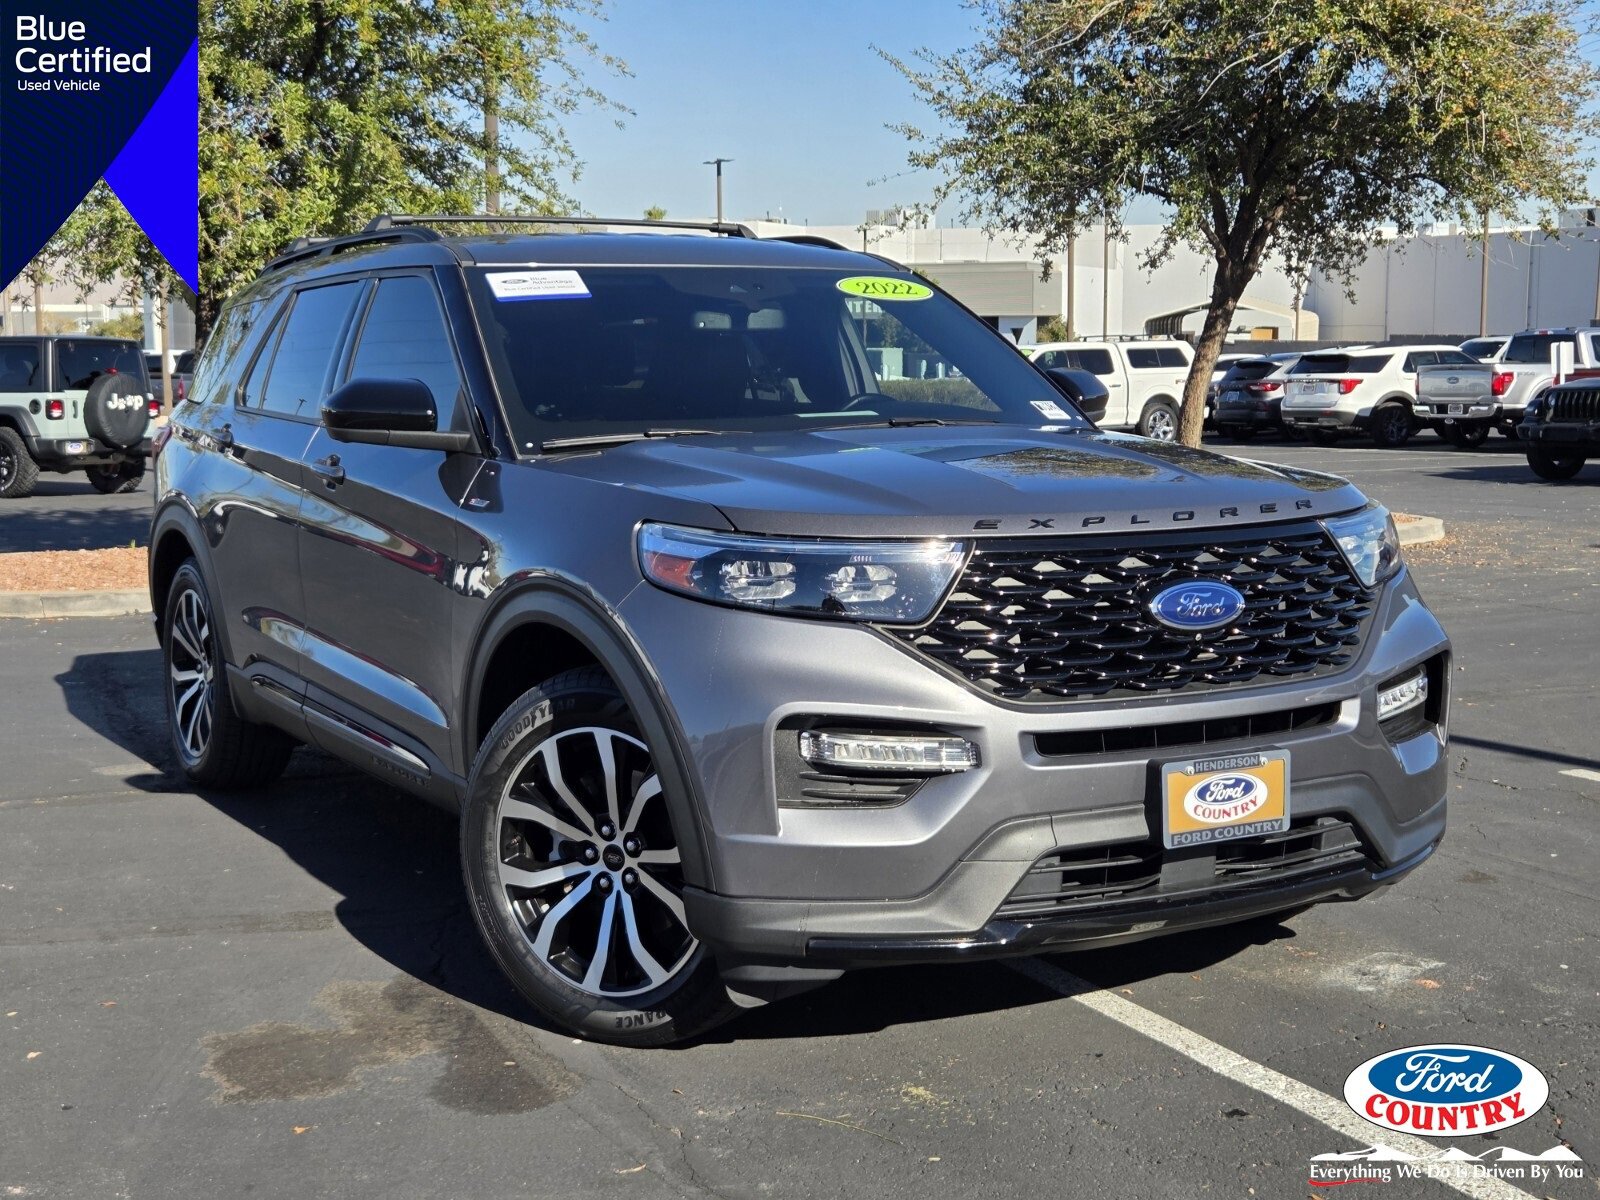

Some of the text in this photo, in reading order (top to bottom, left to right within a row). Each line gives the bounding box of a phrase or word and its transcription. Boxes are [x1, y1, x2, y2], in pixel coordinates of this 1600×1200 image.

[856, 281, 918, 295] 2022
[106, 392, 144, 411] Jeep
[972, 499, 1313, 530] EXPLORER
[1178, 591, 1226, 618] Ford
[1195, 755, 1258, 773] HENDERSON
[1205, 778, 1246, 802] Ford
[1193, 796, 1258, 819] COUNTRY
[1173, 820, 1281, 846] FORD COUNTRY
